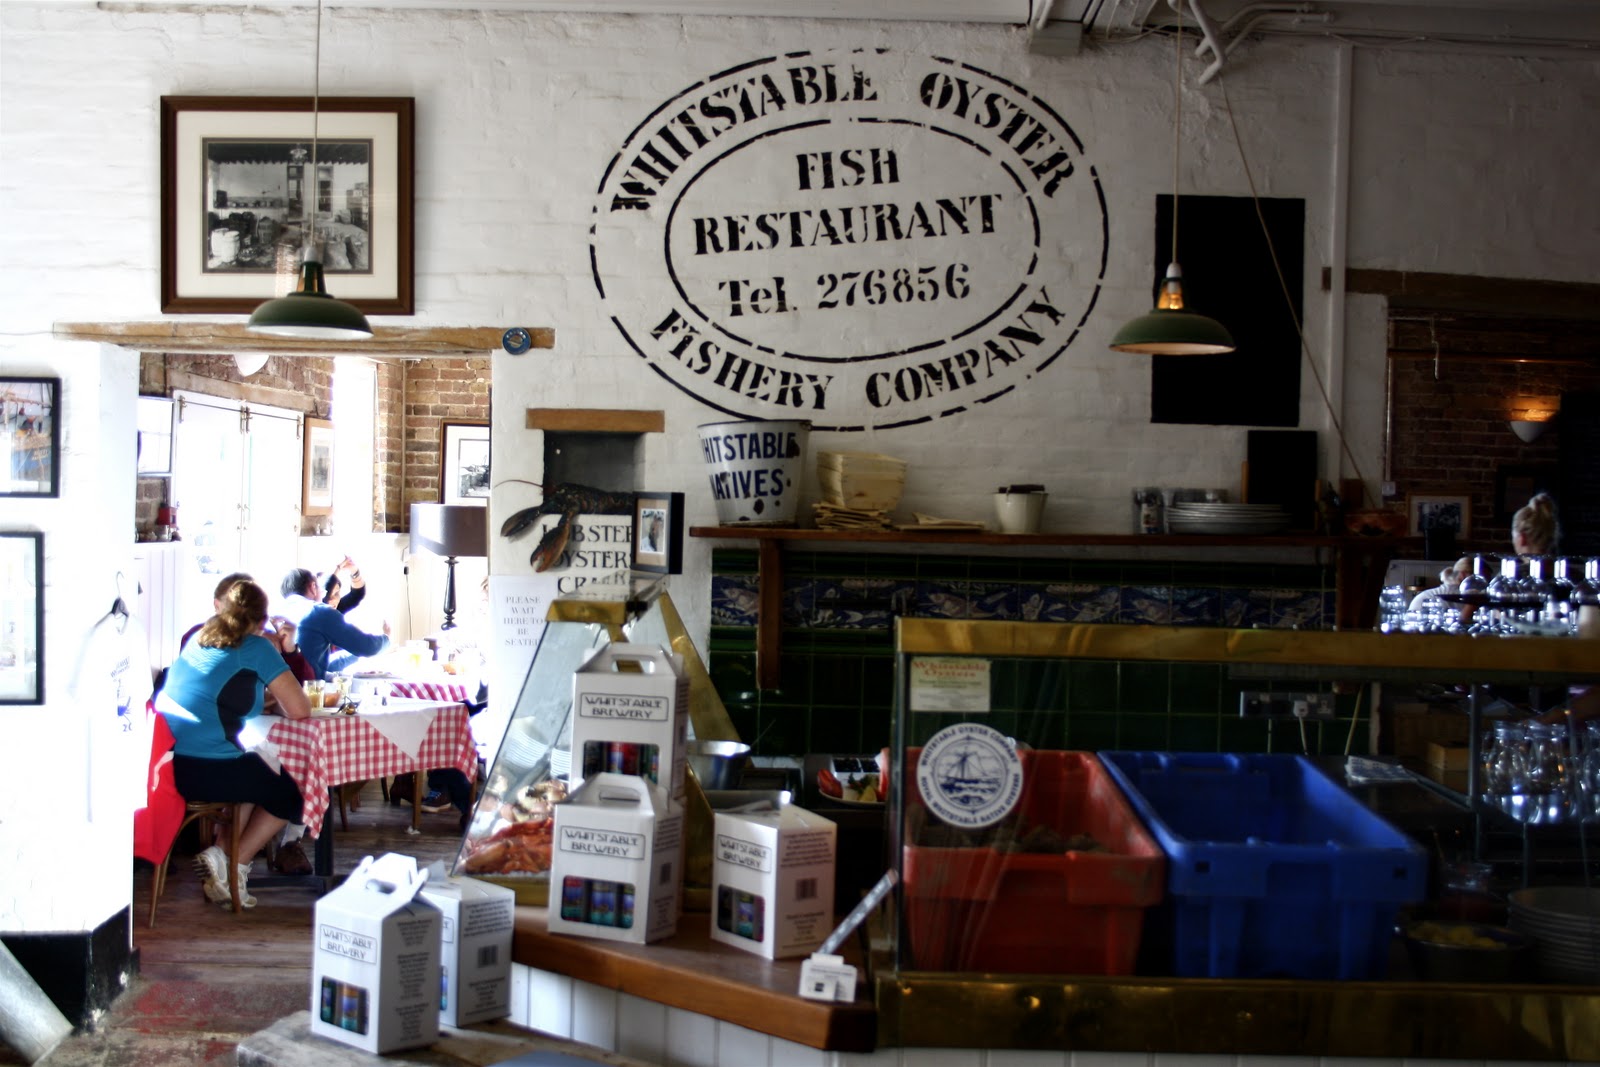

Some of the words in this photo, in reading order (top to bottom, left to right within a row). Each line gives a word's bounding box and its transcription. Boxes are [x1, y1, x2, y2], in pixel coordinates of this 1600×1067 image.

[610, 63, 878, 214] WHITSTABLE
[919, 71, 1076, 199] OYSTER
[795, 146, 900, 192] FISH
[693, 193, 1003, 256] RESTAURANT
[718, 276, 798, 318] Tel.
[816, 262, 971, 310] 276856
[649, 307, 836, 411] FISHERY
[864, 285, 1066, 410] COMPANY
[542, 523, 633, 543] BSTE
[552, 550, 633, 569] YSTER
[506, 596, 541, 604] PLEASE
[511, 606, 536, 614] WAIT
[503, 617, 529, 625] HERE
[530, 617, 544, 625] TO
[585, 695, 663, 709] WHITSTABLE
[592, 707, 653, 719] BREWERY
[564, 828, 639, 847] WHITSTABLE
[571, 842, 630, 857] BREWERY
[719, 837, 767, 860] WHITSTABLE
[723, 851, 762, 869] BREWERY
